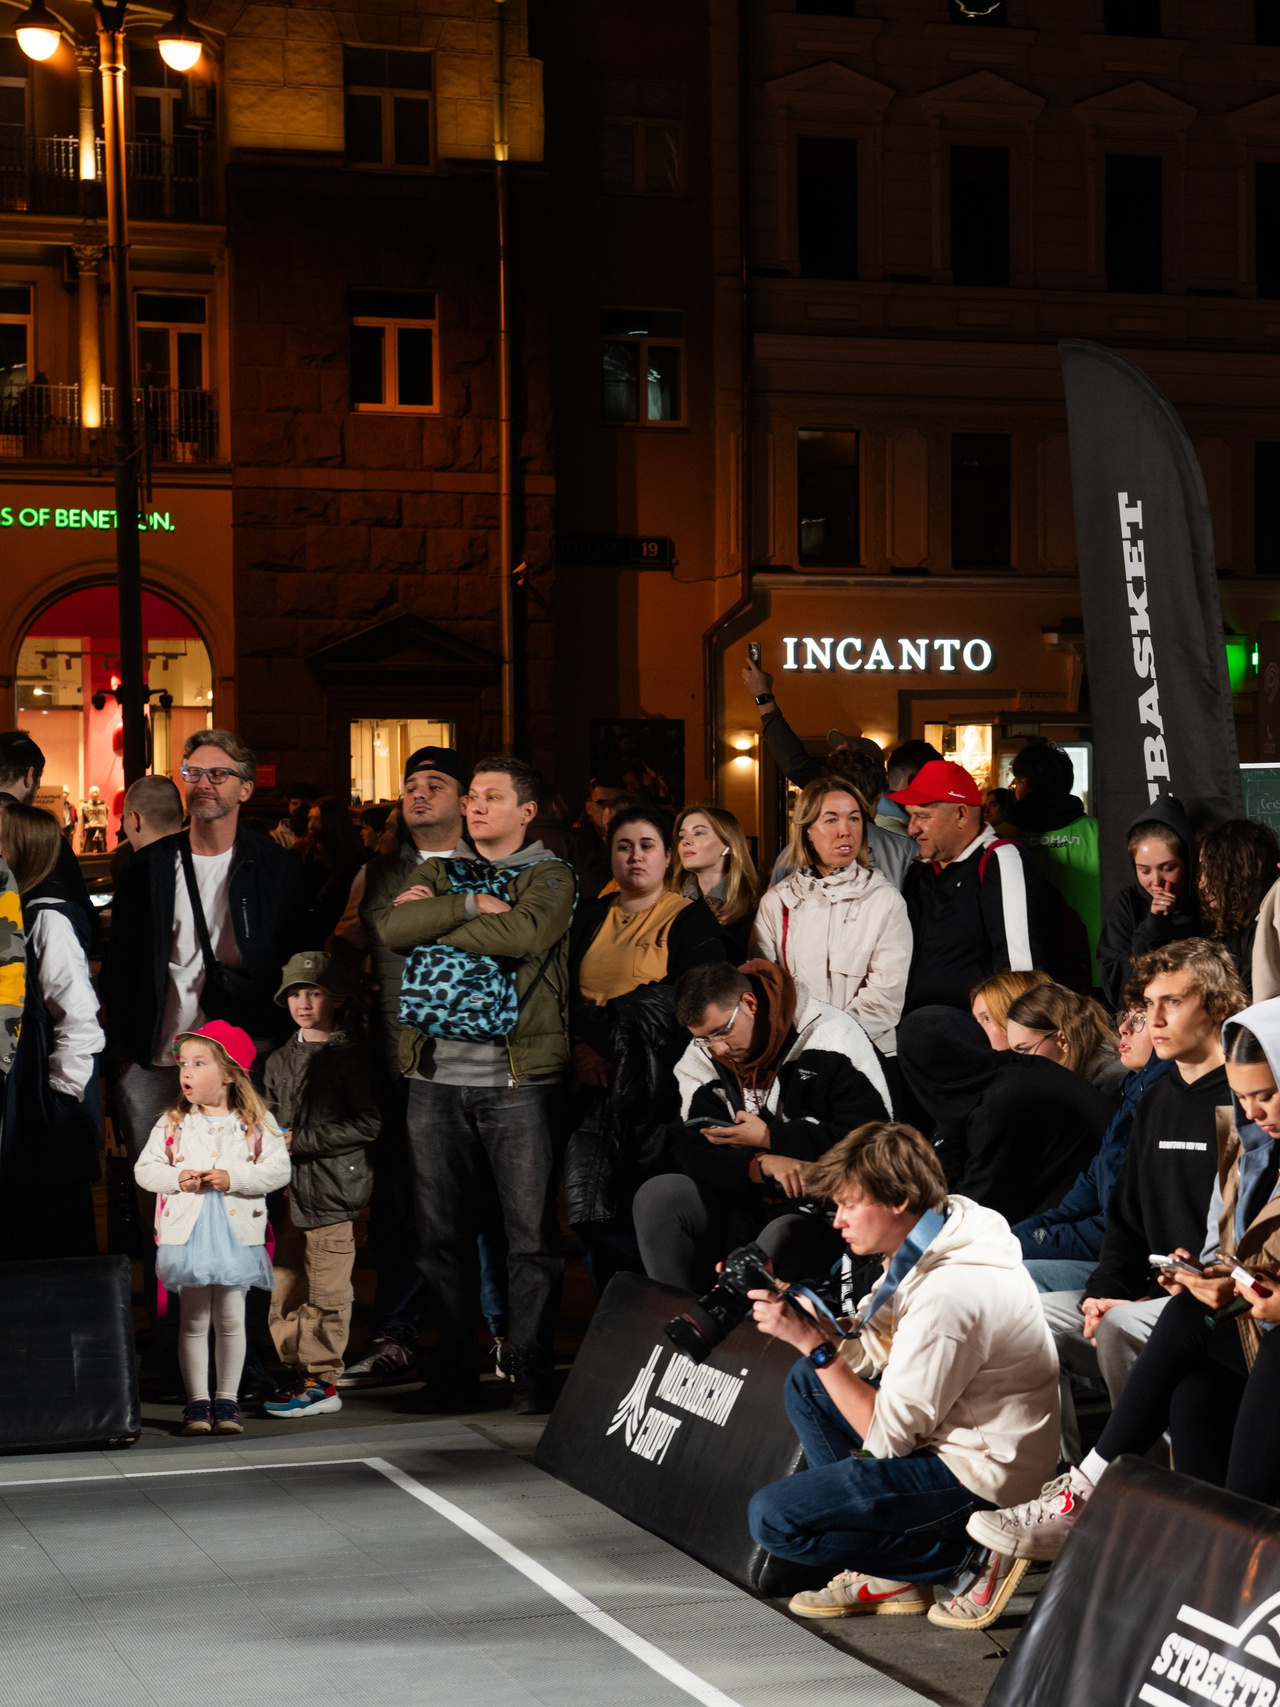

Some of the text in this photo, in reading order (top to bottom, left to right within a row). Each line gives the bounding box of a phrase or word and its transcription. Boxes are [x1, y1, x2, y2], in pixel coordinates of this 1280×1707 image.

[18, 507, 51, 527] OF
[55, 508, 175, 531] BENETN.
[641, 541, 659, 557] 19
[782, 637, 993, 672] INCANTO
[630, 1406, 683, 1466] СПОРТ
